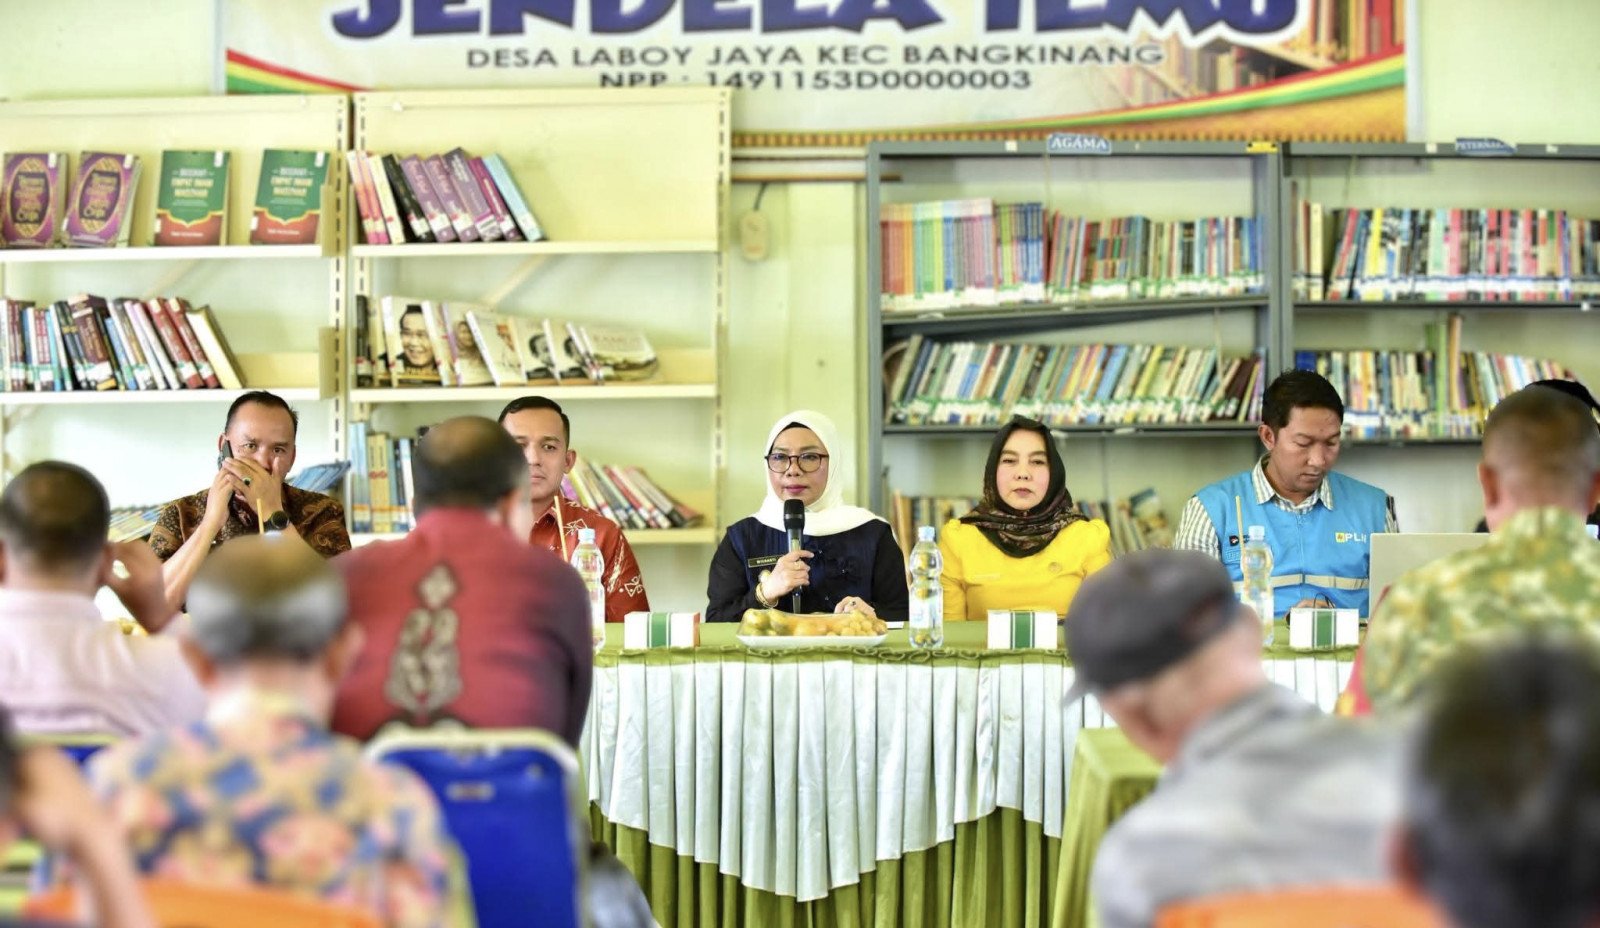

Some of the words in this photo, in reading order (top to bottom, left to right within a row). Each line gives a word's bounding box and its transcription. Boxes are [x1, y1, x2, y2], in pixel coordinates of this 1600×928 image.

[466, 48, 558, 68] DESA
[572, 47, 693, 67] LABOY
[707, 46, 803, 65] JAYA
[817, 45, 889, 65] KEC
[903, 44, 1164, 64] BANGKINANG
[599, 71, 668, 88] NPP
[707, 69, 1031, 90] 1491153D0000003
[1051, 136, 1108, 150] AGAMA
